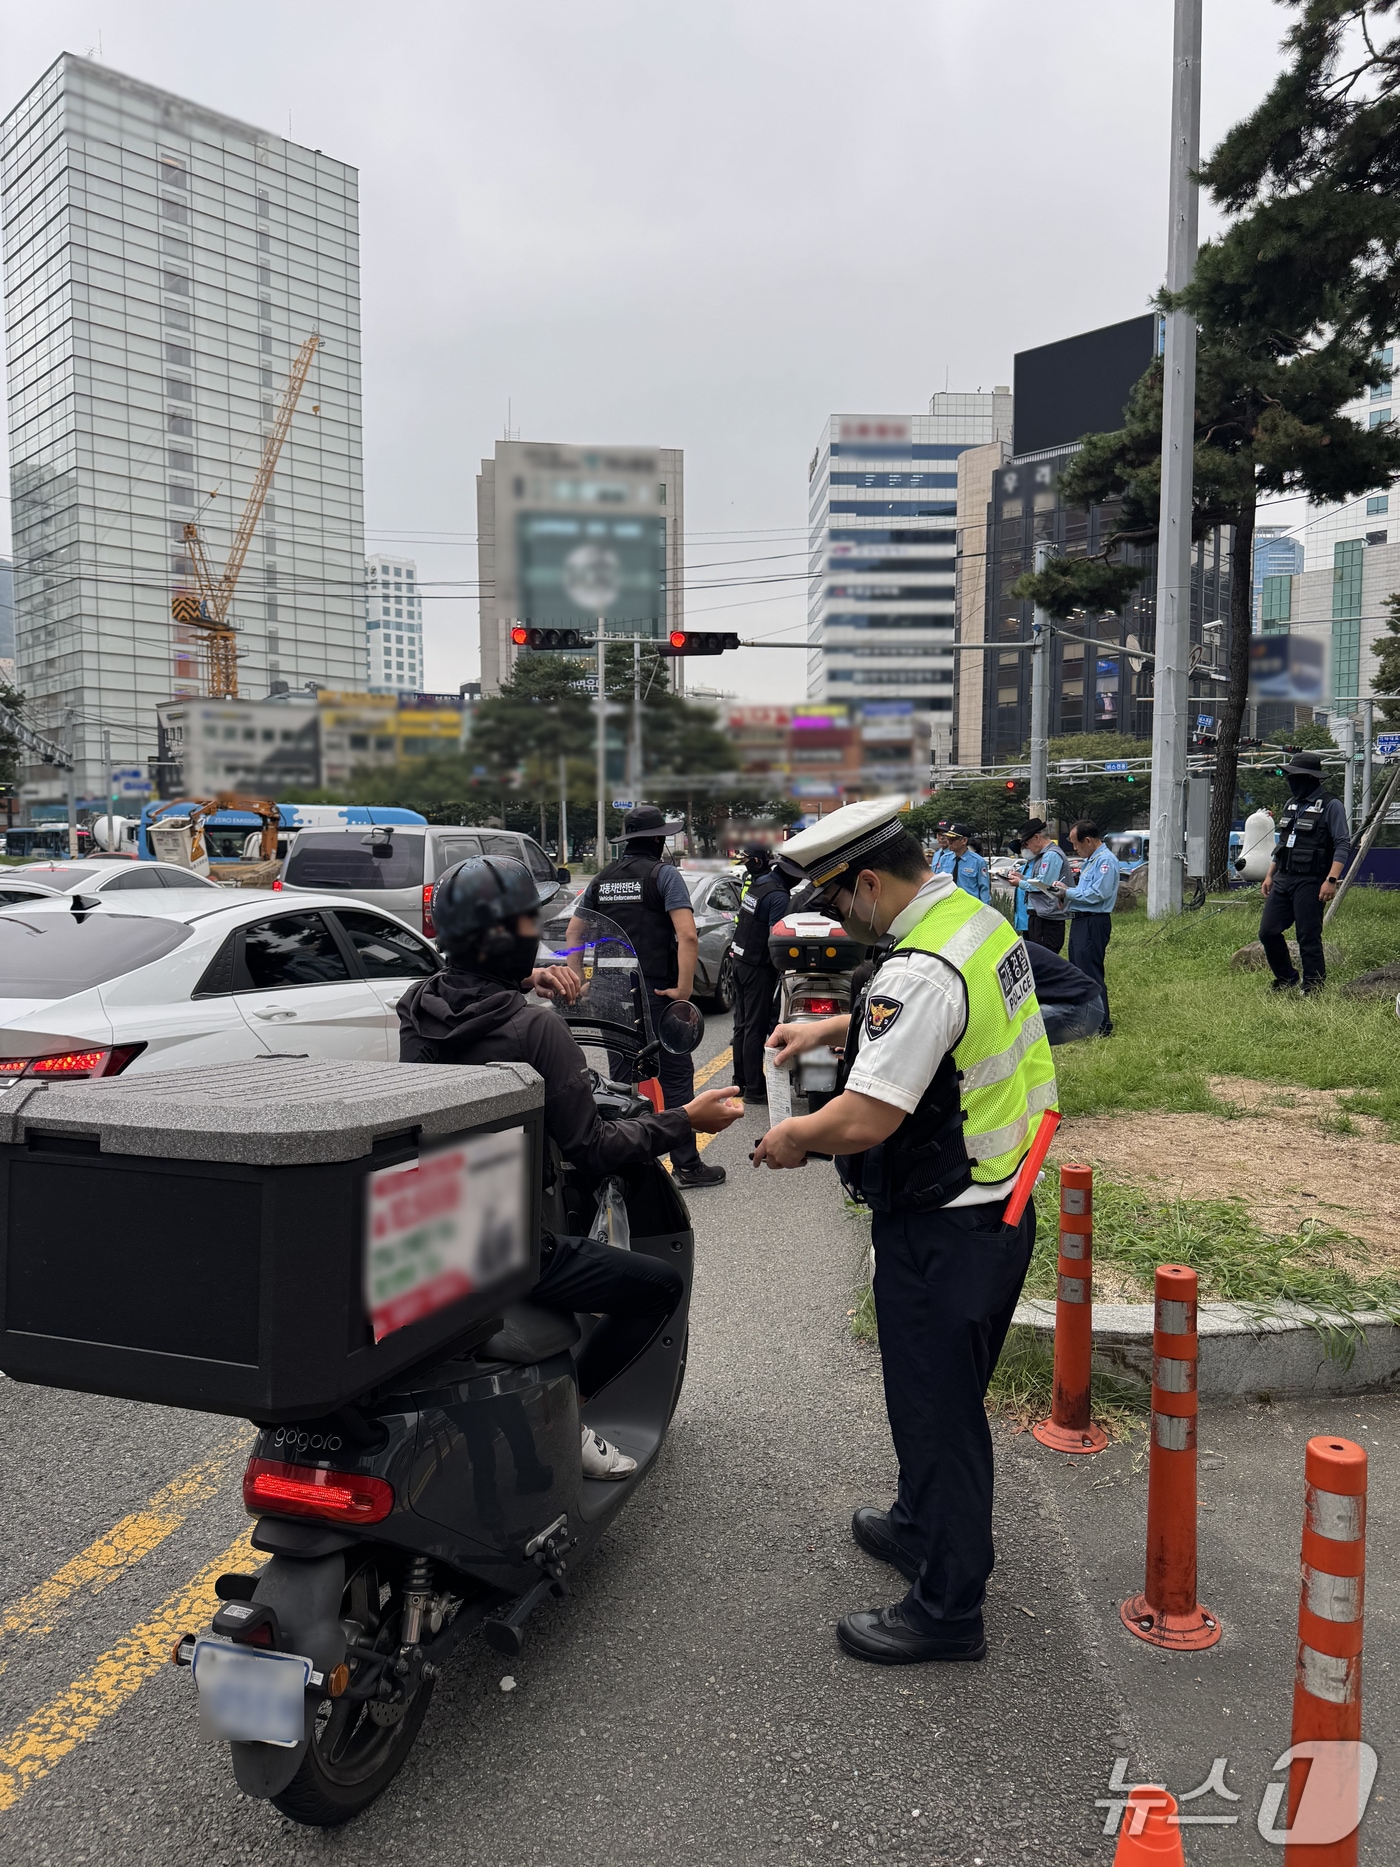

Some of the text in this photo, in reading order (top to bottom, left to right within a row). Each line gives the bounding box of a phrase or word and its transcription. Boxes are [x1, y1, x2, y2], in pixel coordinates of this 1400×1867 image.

[1106, 762, 1127, 770] 버스전용
[599, 881, 641, 894] 자동차안전단속
[1009, 975, 1032, 1012] POLICE
[274, 1425, 343, 1453] gogoro
